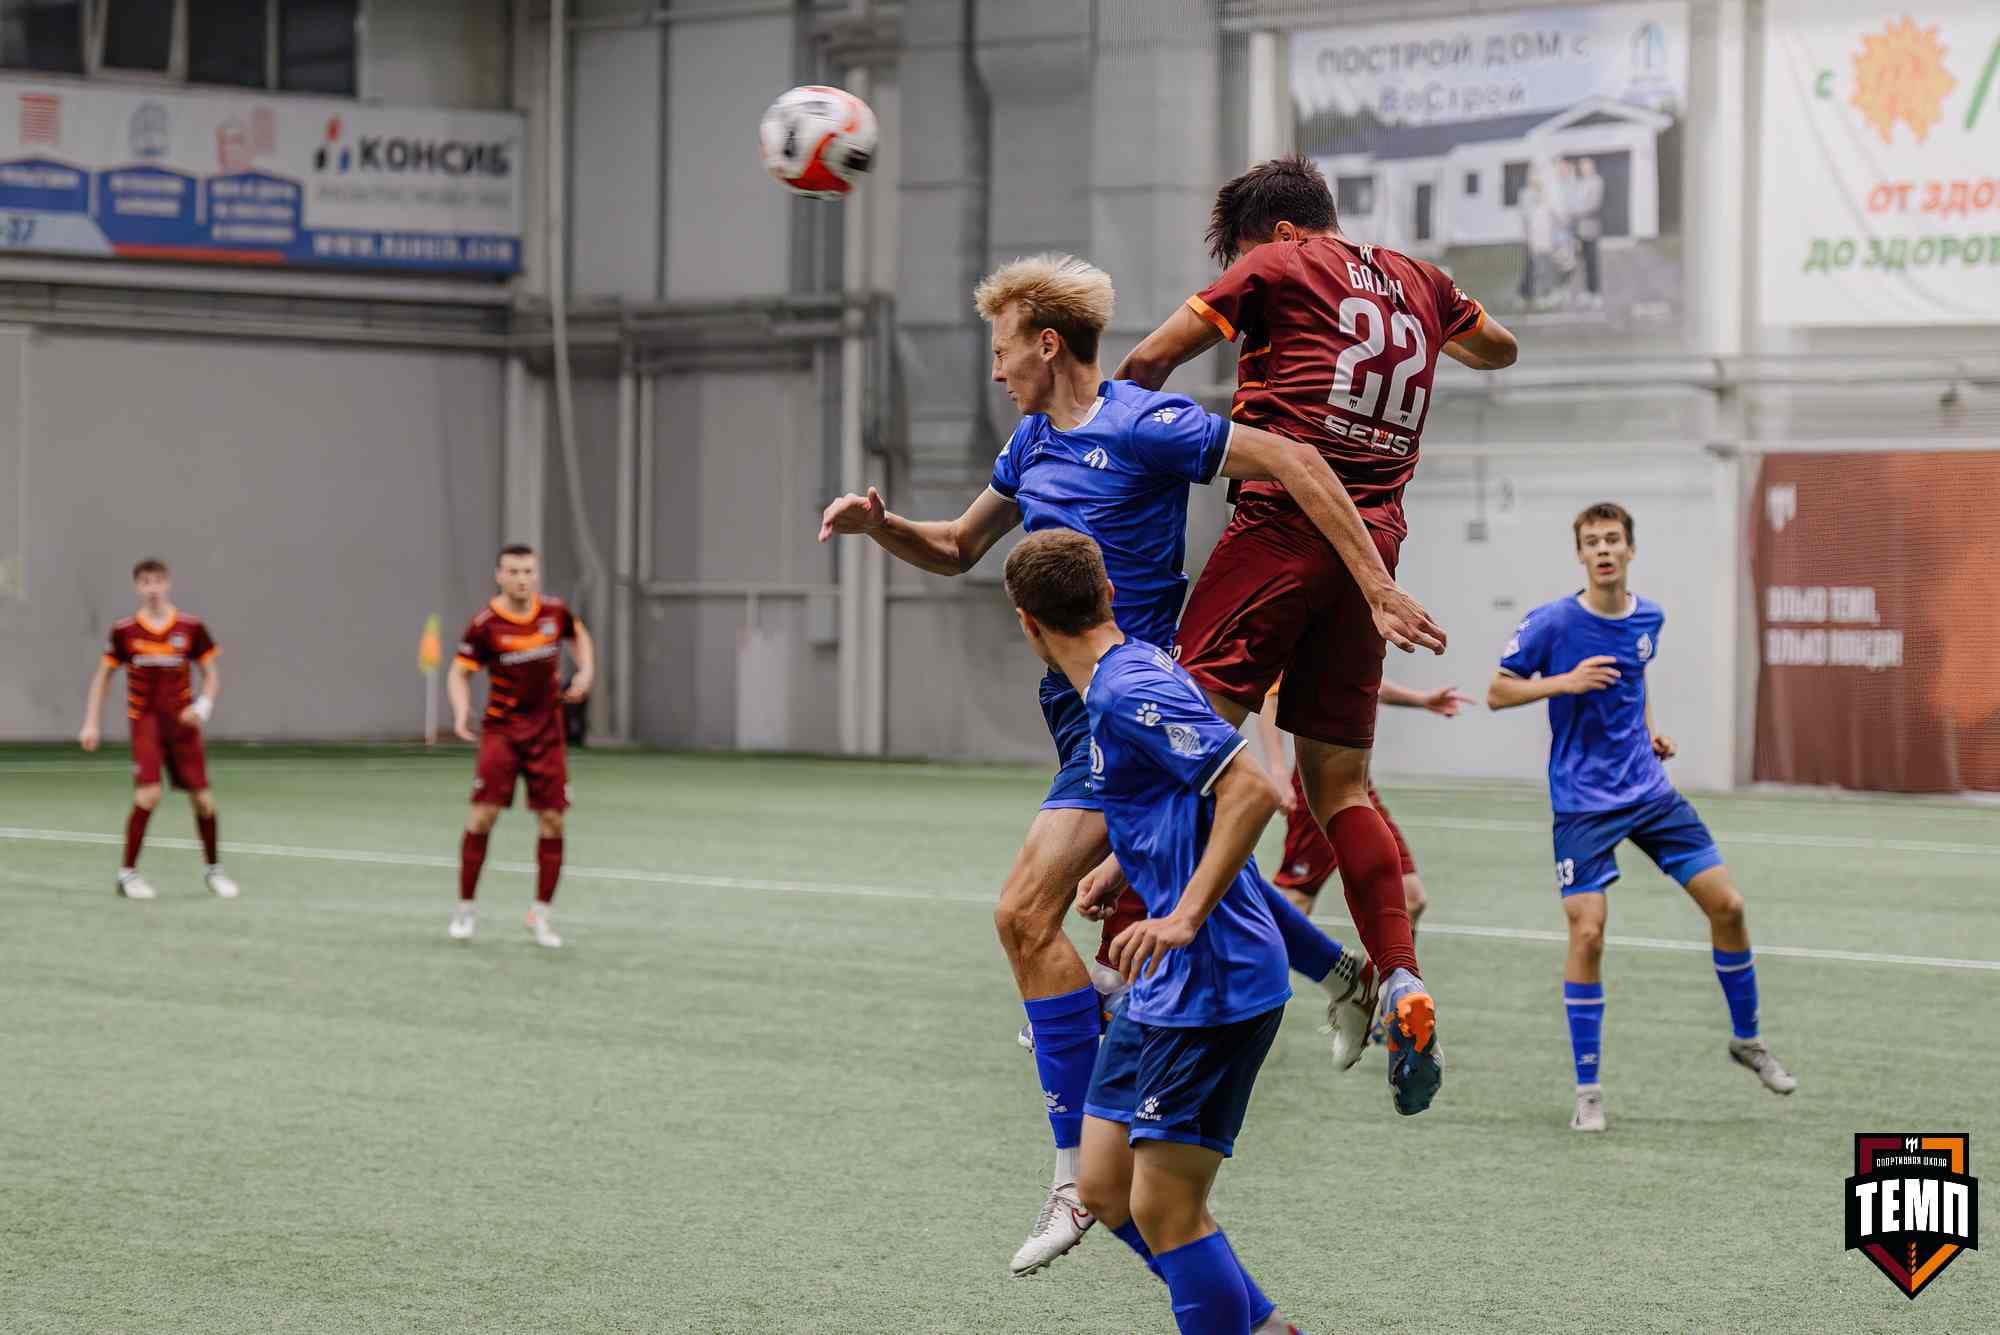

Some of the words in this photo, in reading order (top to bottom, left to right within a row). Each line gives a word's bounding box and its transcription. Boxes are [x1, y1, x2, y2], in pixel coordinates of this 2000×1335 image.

[1483, 30, 1561, 68] ДОМ
[1867, 180, 1914, 213] ОТ
[1920, 178, 2000, 219] ЗДО
[1803, 238, 1856, 275] ДО
[1328, 297, 1428, 432] 22
